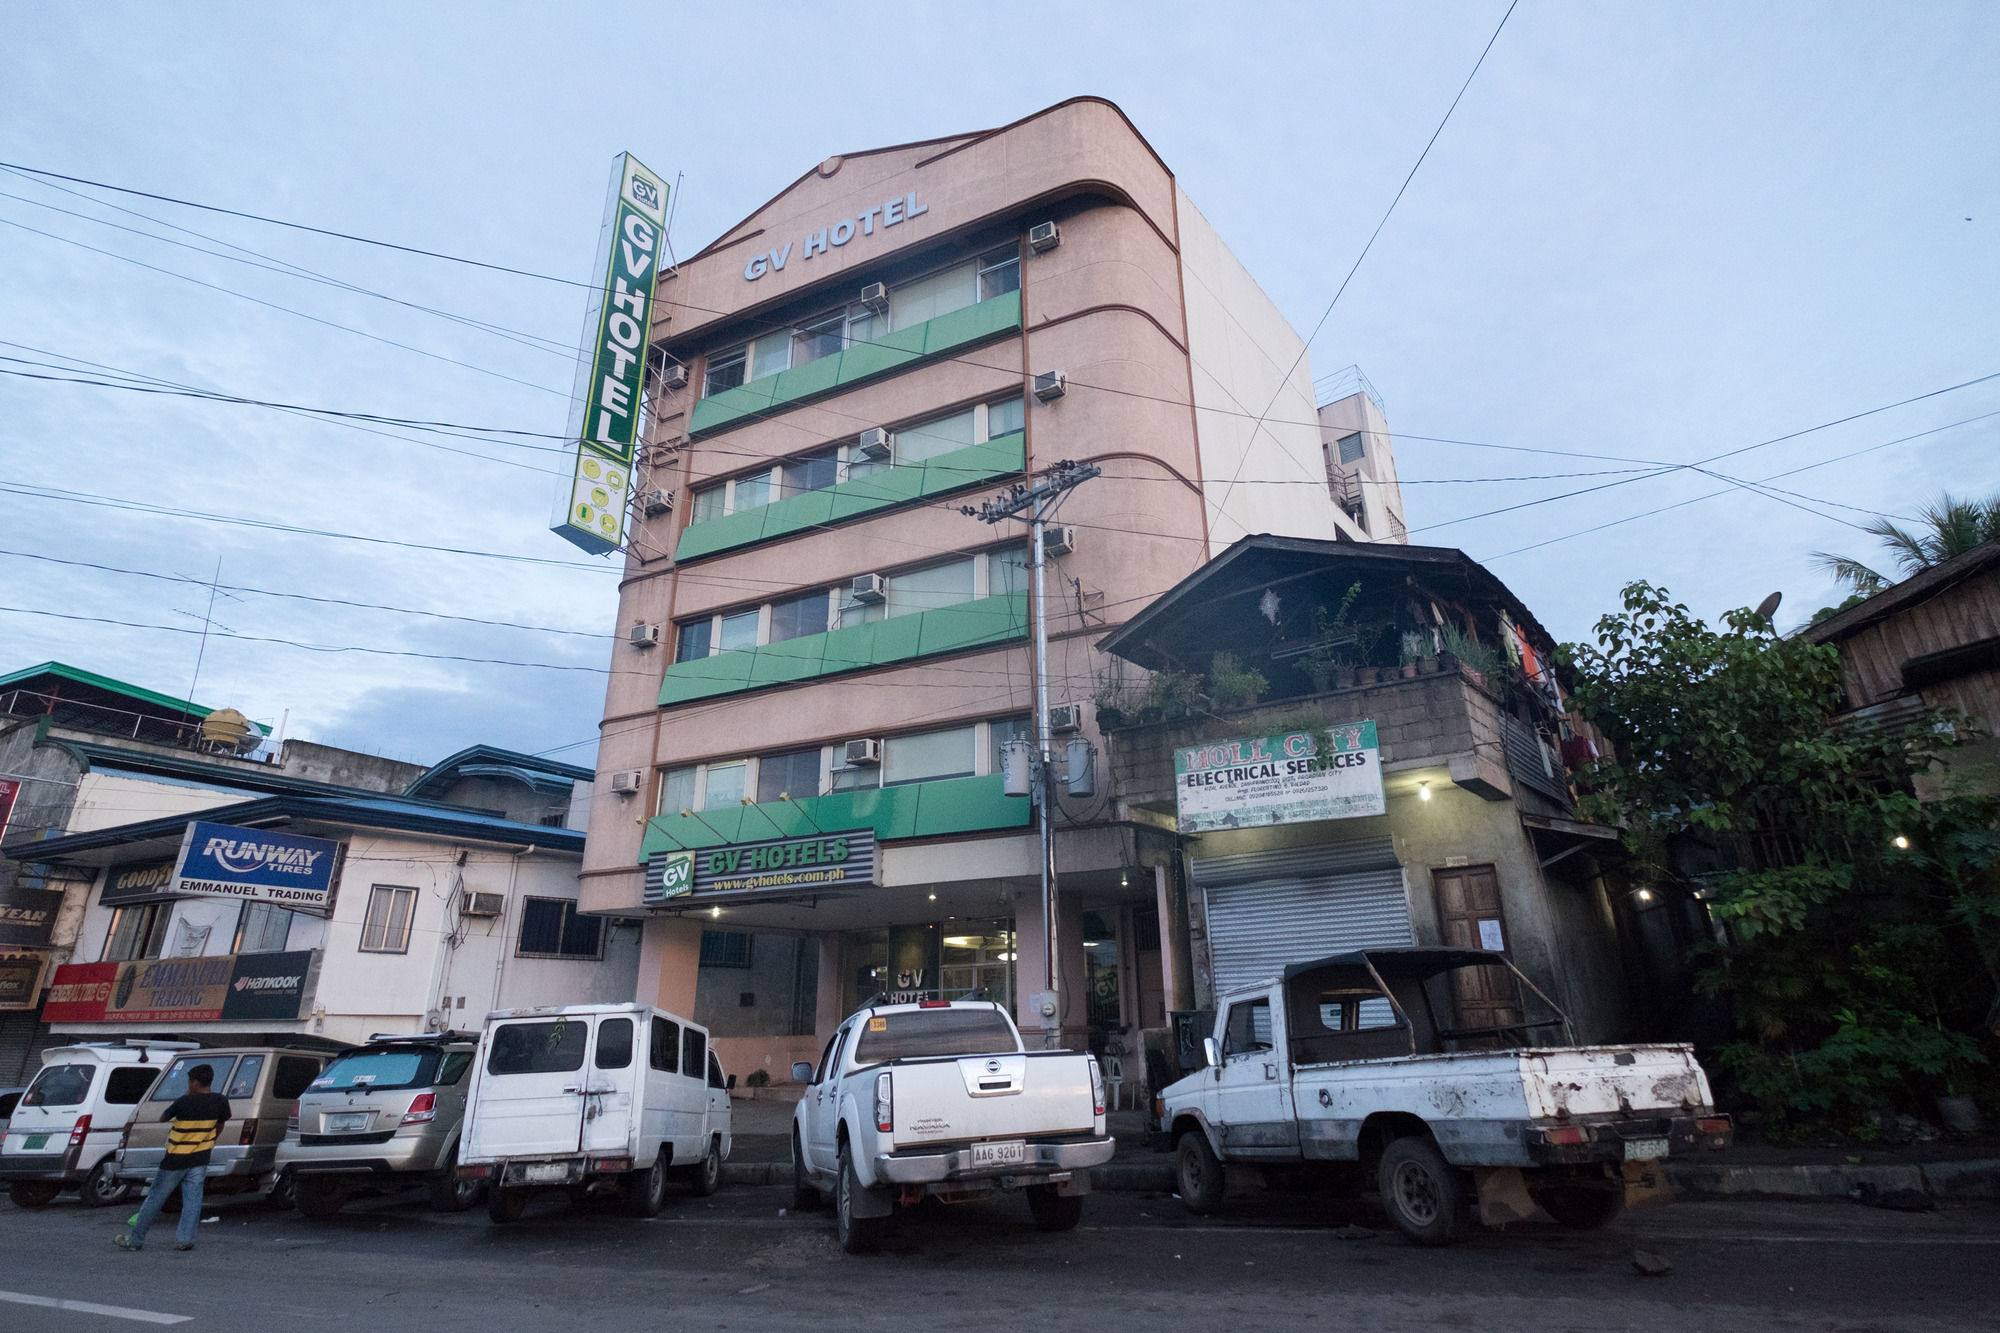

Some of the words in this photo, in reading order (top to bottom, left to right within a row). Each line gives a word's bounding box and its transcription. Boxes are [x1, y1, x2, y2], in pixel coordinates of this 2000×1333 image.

[633, 181, 657, 201] GV
[744, 240, 793, 282] GV
[803, 191, 929, 260] HOTEL
[1187, 763, 1280, 787] ELECTRICAL
[203, 838, 324, 868] RUNWAY
[709, 850, 742, 874] GV
[750, 839, 849, 870] HOTELS
[269, 863, 313, 875] TIRES
[663, 862, 690, 887] GV
[714, 868, 845, 890] www.gvhotels.com.ph
[180, 880, 258, 896] EMMANUEL
[267, 888, 323, 901] TRADING
[666, 884, 689, 897] Hotels
[139, 962, 230, 989] EMMANUEL
[897, 968, 923, 988] GV
[148, 988, 203, 1008] TRADING
[975, 1148, 994, 1161] AAG
